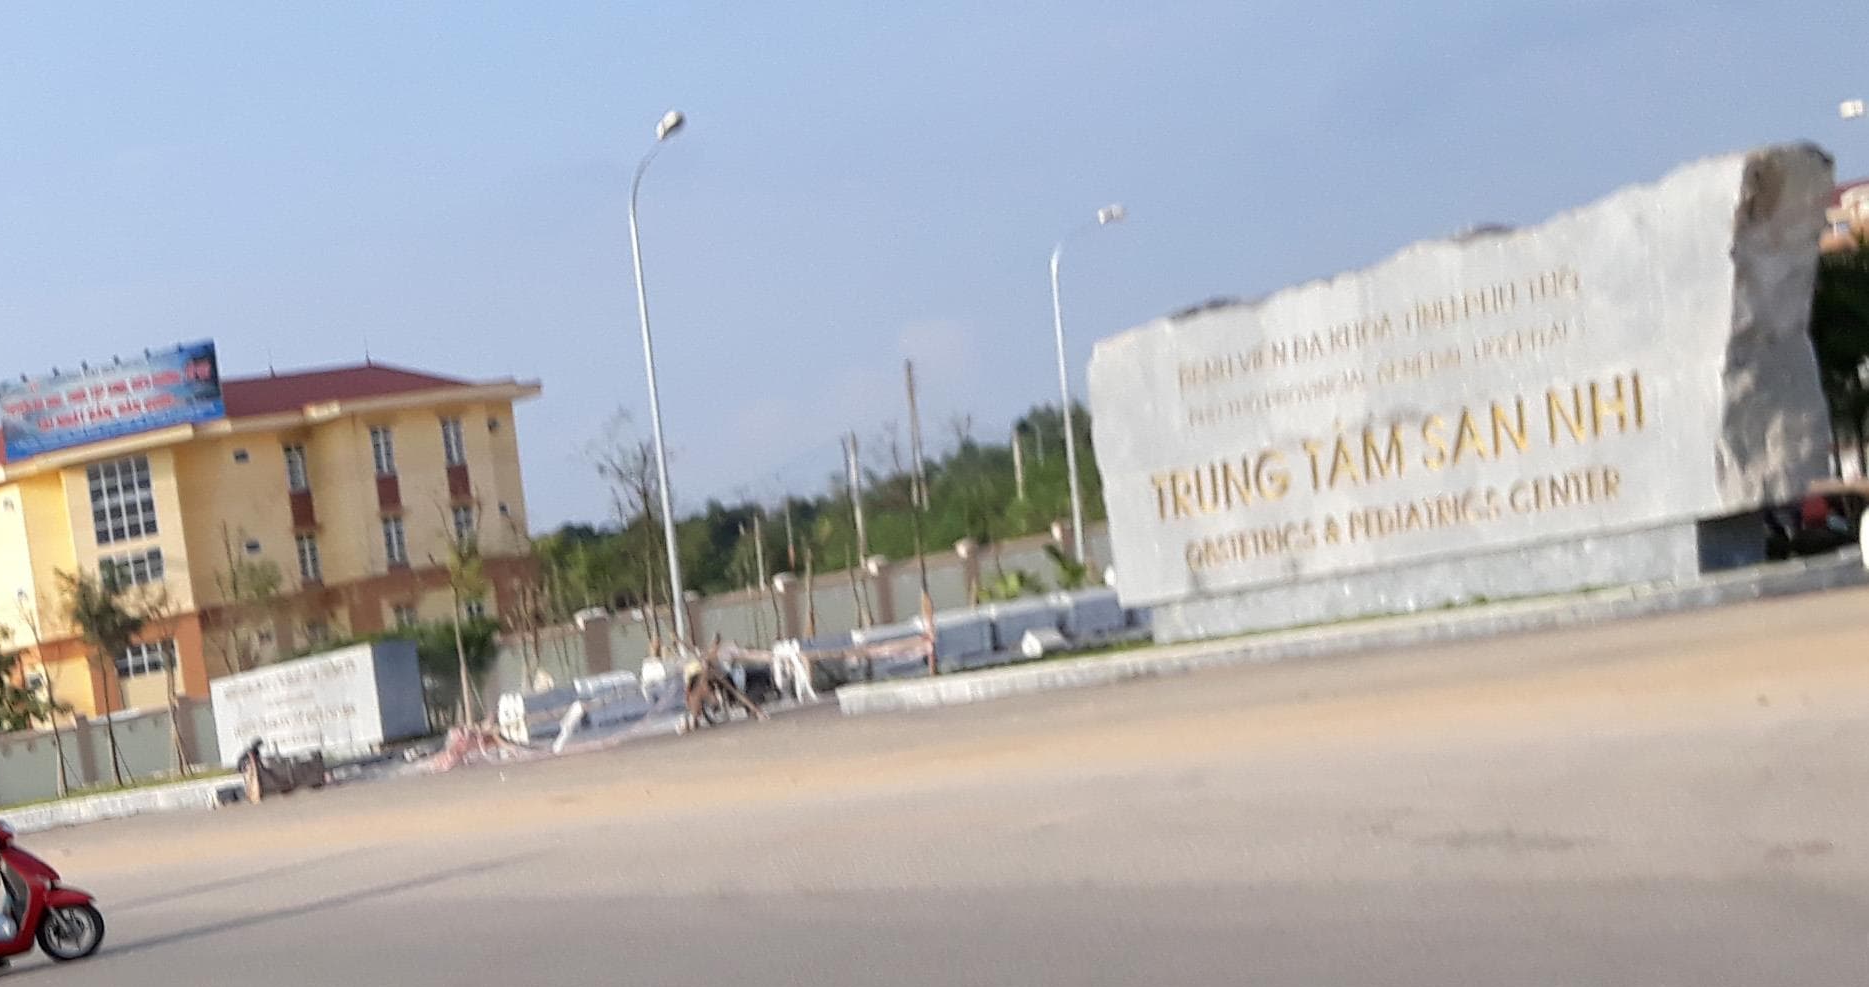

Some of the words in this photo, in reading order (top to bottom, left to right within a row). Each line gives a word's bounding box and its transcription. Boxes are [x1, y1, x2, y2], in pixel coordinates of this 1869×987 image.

[1150, 447, 1293, 522] TRUNG
[1545, 367, 1646, 449] NHI
[1508, 463, 1621, 513] CENTER
